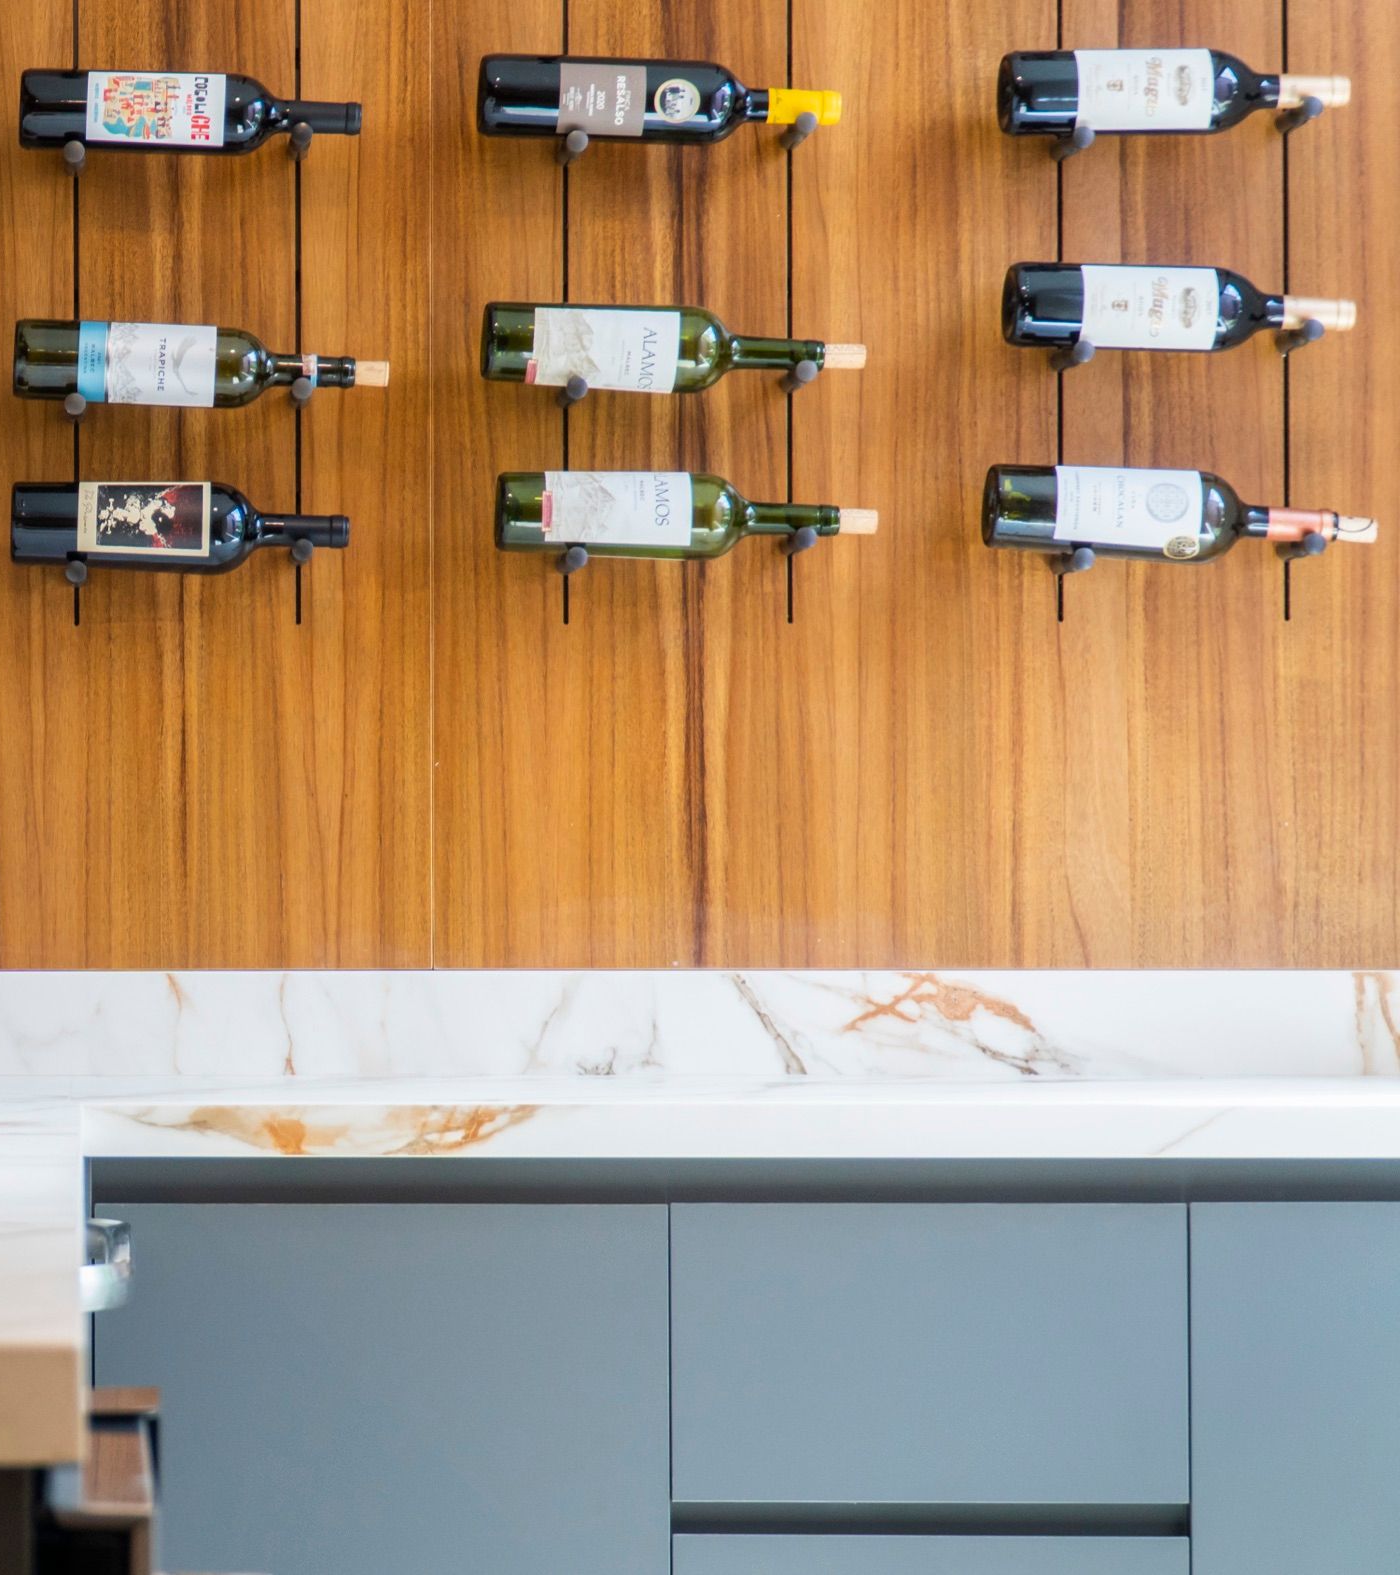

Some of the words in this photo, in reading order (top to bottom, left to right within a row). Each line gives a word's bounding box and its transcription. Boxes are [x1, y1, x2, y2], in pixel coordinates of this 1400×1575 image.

[596, 91, 606, 110] 2020
[614, 75, 626, 126] RESALSO
[157, 337, 167, 392] TRAPICHE
